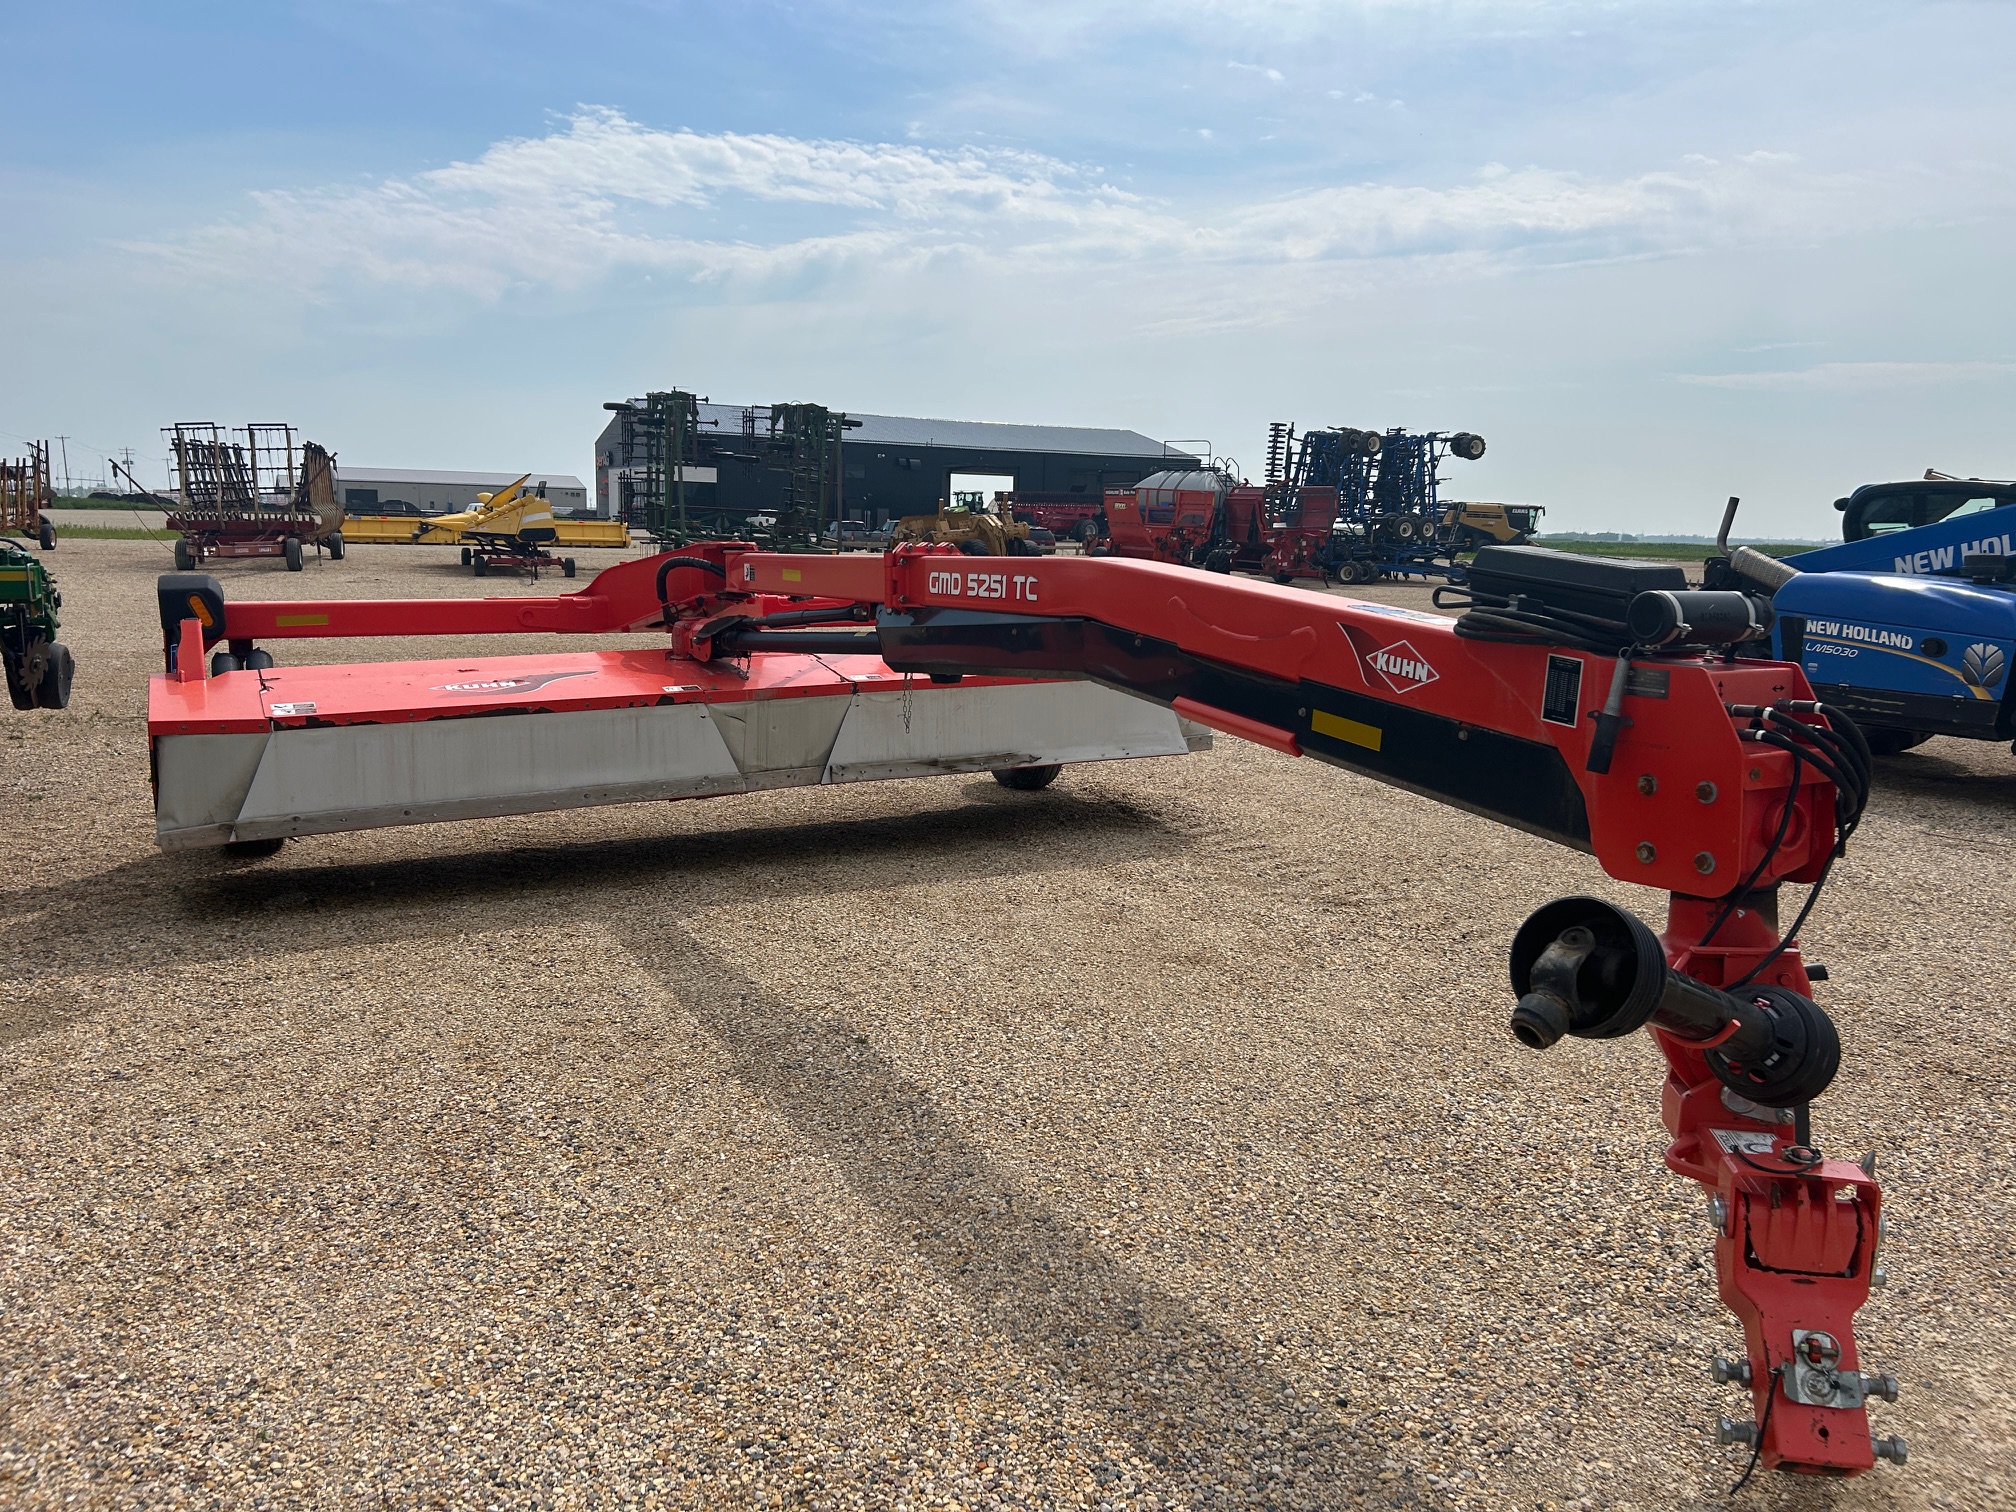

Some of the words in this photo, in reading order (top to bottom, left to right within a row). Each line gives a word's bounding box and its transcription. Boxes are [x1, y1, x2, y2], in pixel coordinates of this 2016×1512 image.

[1894, 545, 1955, 576] NEW
[929, 571, 961, 596] GMD
[966, 573, 1007, 600] 5251
[1012, 575, 1039, 602] TC
[1804, 641, 1859, 659] LM5030
[1806, 619, 1841, 637] NEW
[1841, 623, 1914, 651] HOLLAND
[1375, 651, 1429, 683] KUHN
[444, 680, 517, 691] KUHN
